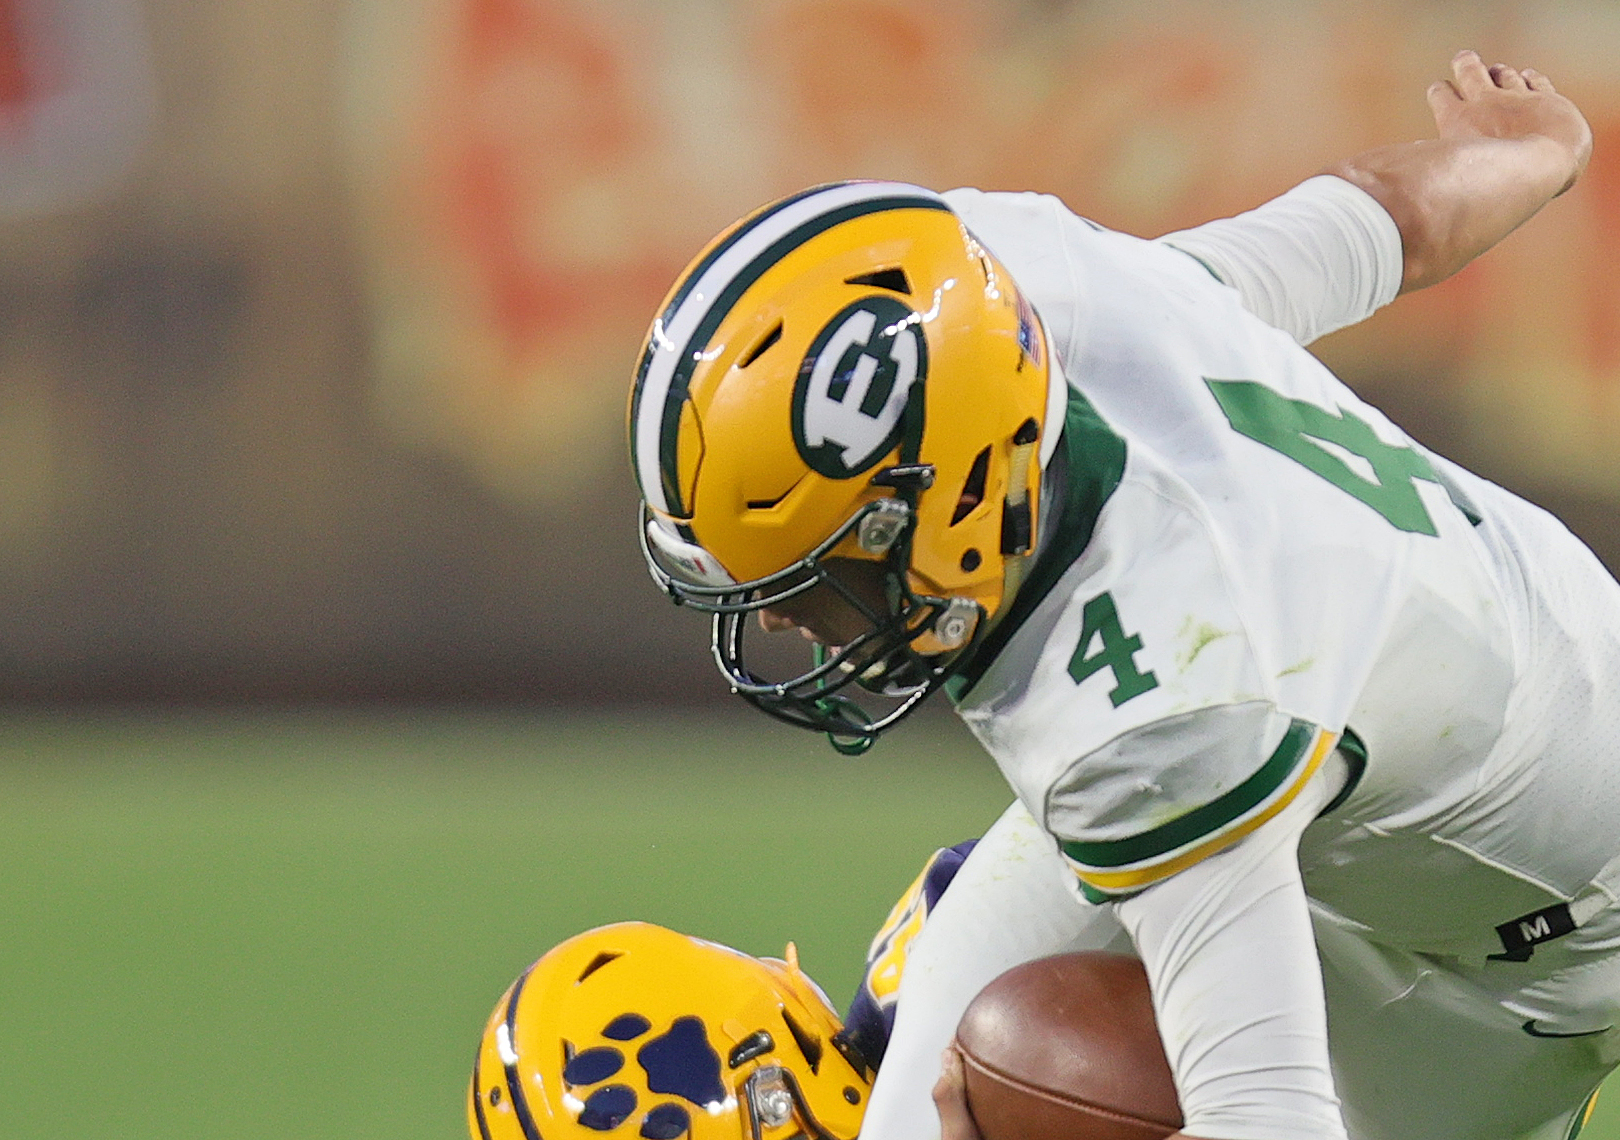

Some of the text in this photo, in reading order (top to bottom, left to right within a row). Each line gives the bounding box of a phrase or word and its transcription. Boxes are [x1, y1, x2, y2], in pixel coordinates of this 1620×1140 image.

[1202, 376, 1481, 538] 4
[1067, 590, 1159, 709] 4
[1519, 916, 1551, 942] M
